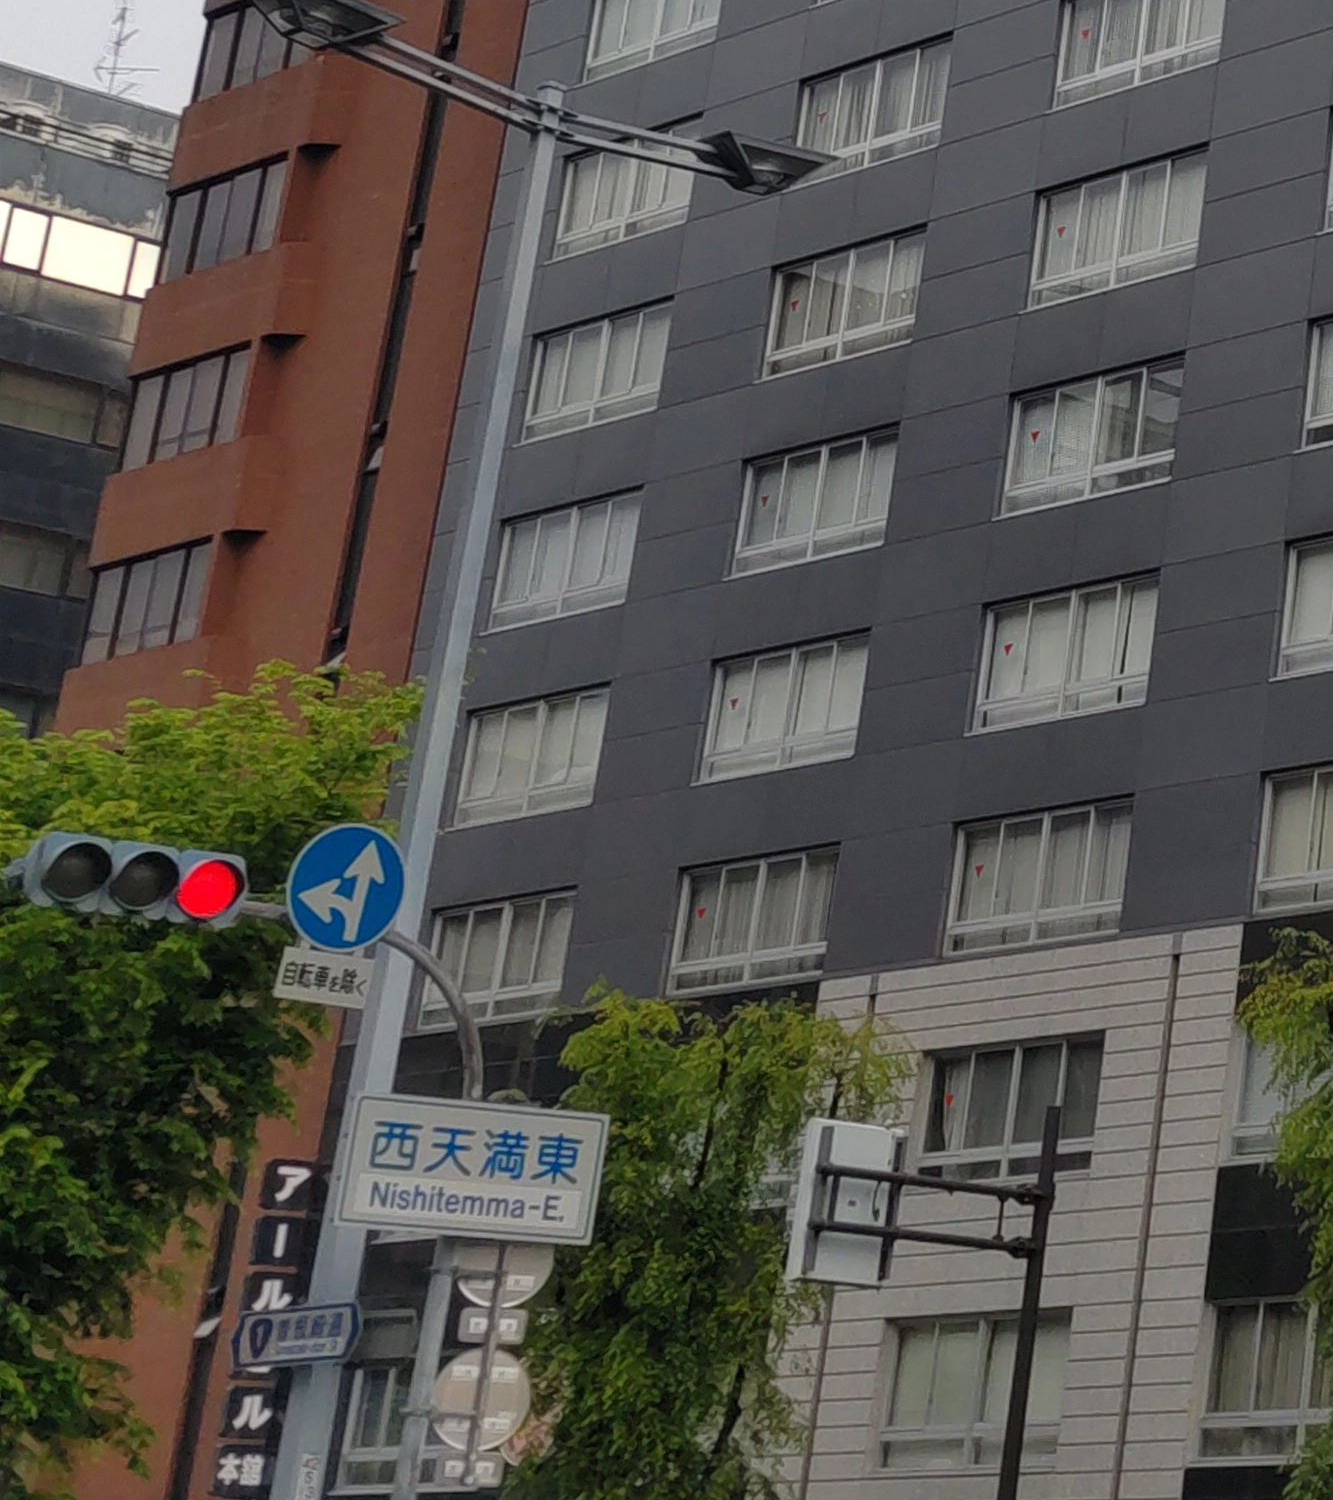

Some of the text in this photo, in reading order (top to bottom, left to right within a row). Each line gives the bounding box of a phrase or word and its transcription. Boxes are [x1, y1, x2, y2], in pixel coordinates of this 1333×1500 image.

[281, 960, 367, 997] 自転車を除く
[369, 1120, 584, 1185] 西天満東
[232, 1165, 313, 1431] アールル
